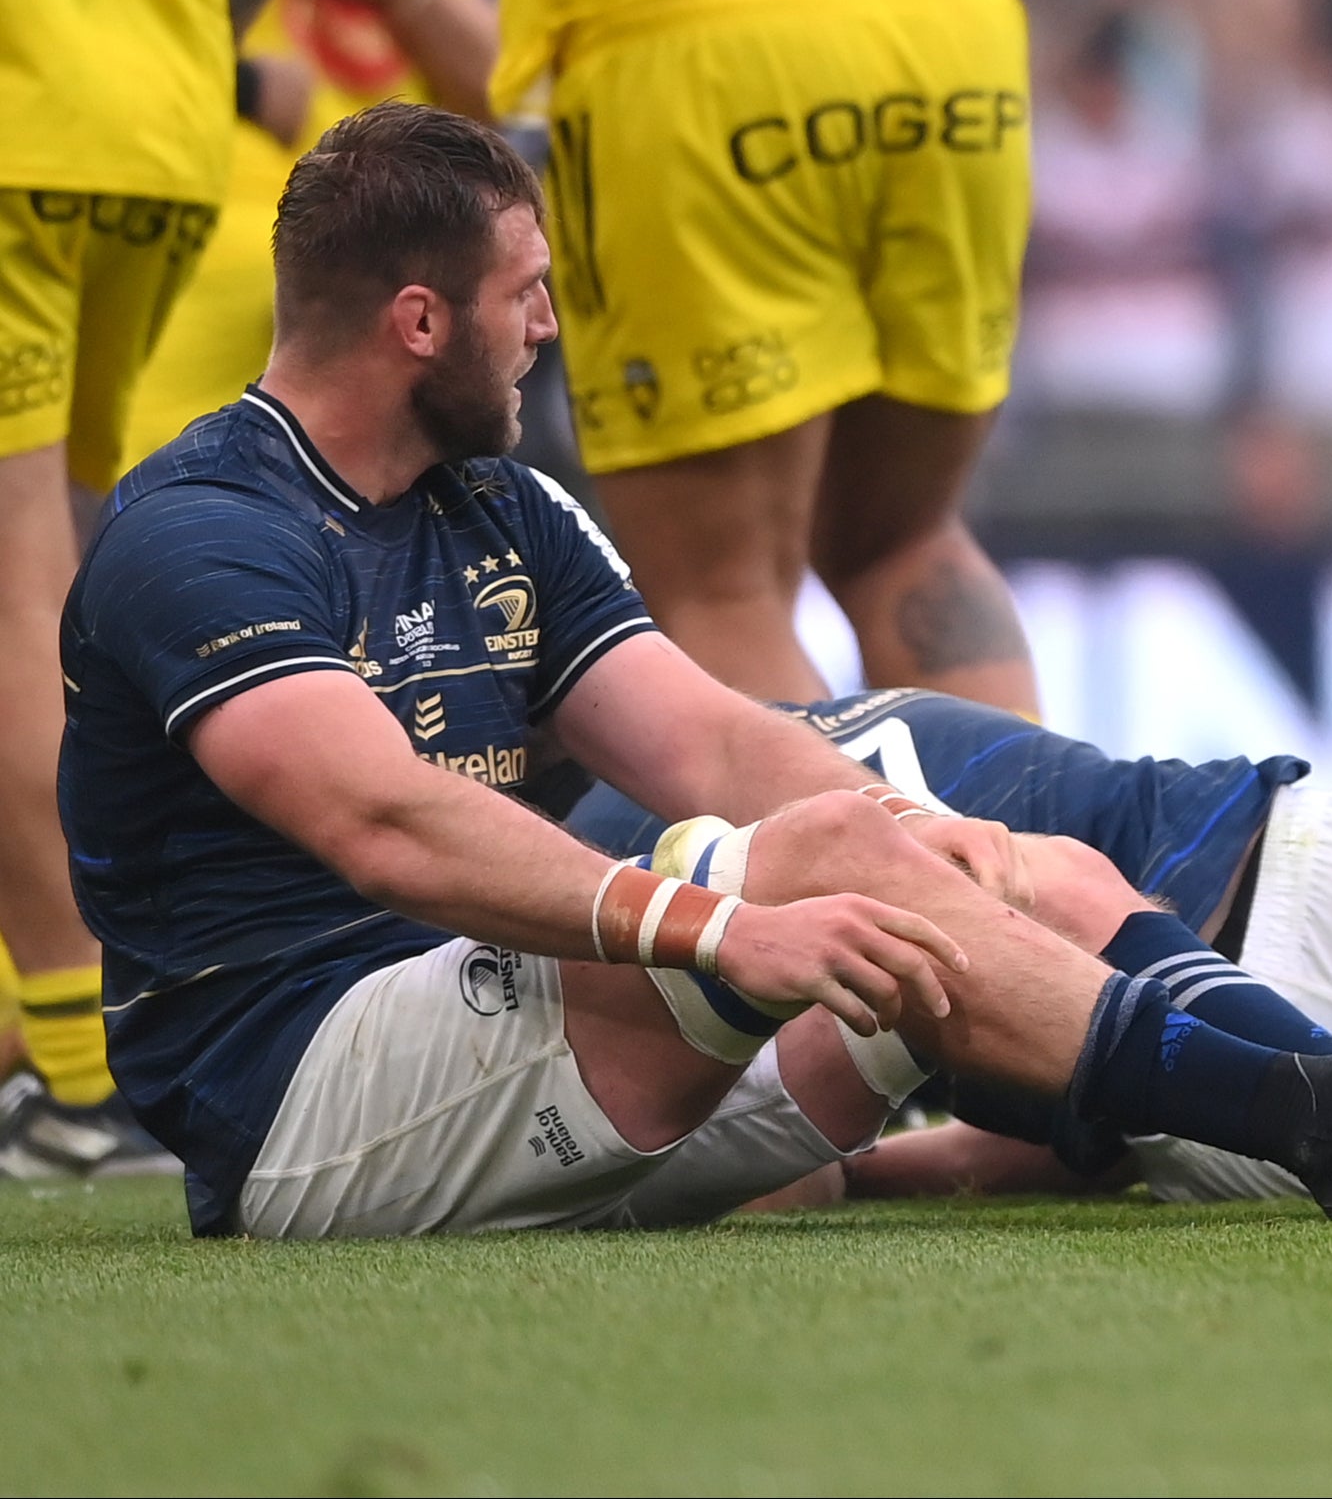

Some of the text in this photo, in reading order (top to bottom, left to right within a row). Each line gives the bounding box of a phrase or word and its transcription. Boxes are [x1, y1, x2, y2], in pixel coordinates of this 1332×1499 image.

[210, 619, 302, 652] Bank of Ireland
[535, 1109, 575, 1168] Bank of
[546, 1104, 586, 1162] Ireland
